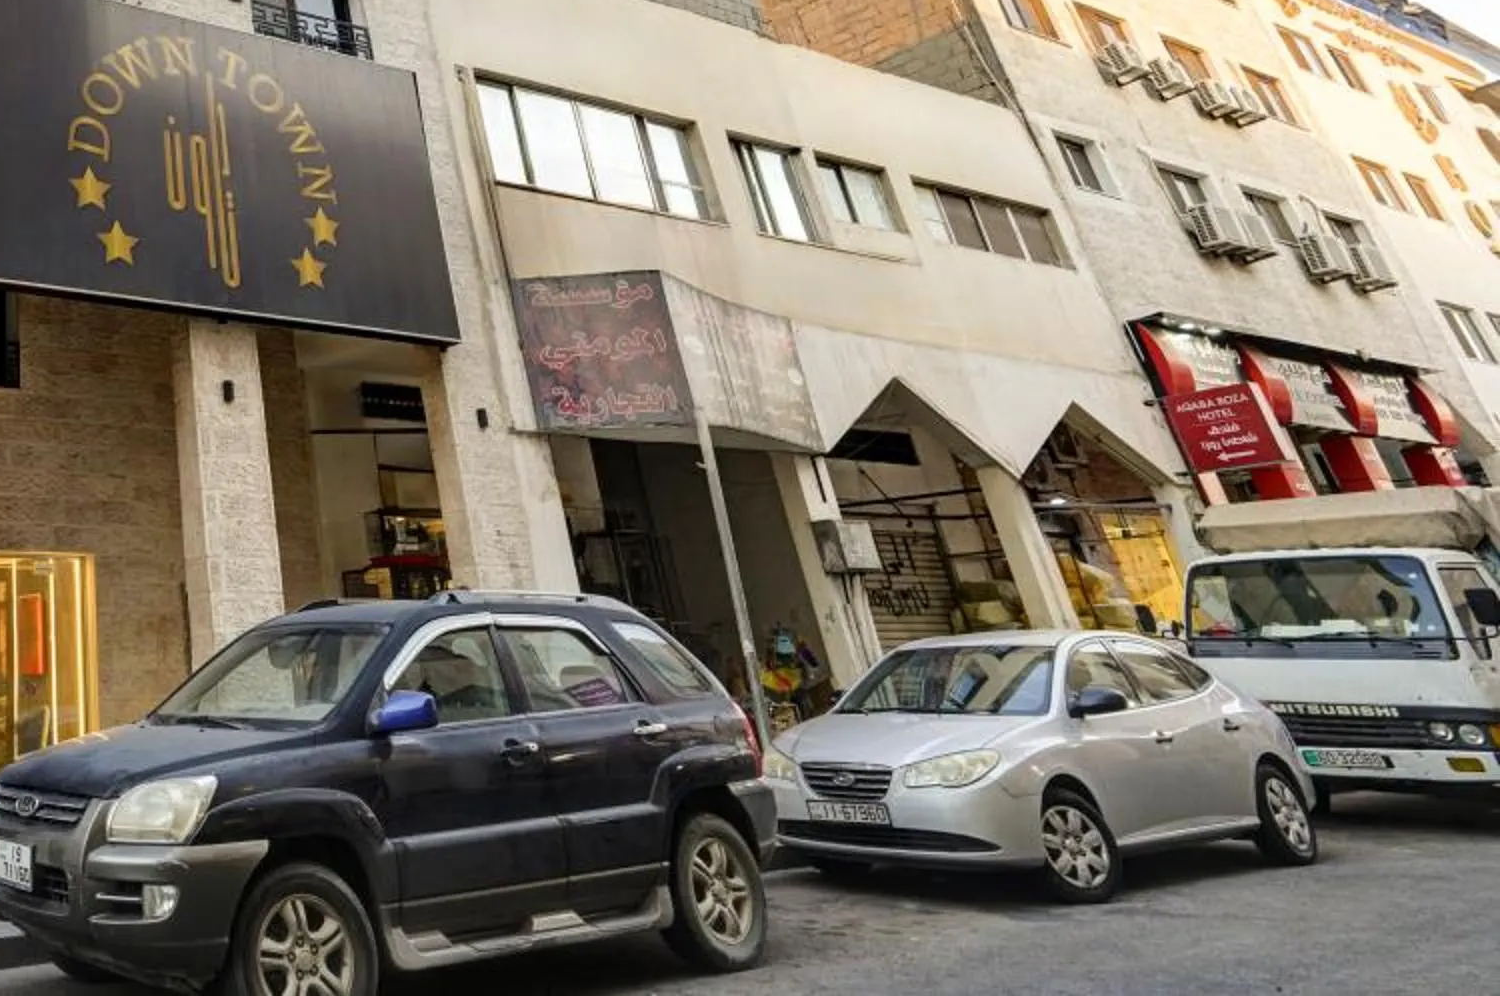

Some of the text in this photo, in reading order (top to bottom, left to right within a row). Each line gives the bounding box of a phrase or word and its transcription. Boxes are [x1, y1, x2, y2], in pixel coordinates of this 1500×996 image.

[67, 35, 338, 205] DOWN TOWN
[1197, 407, 1237, 422] HOTEL
